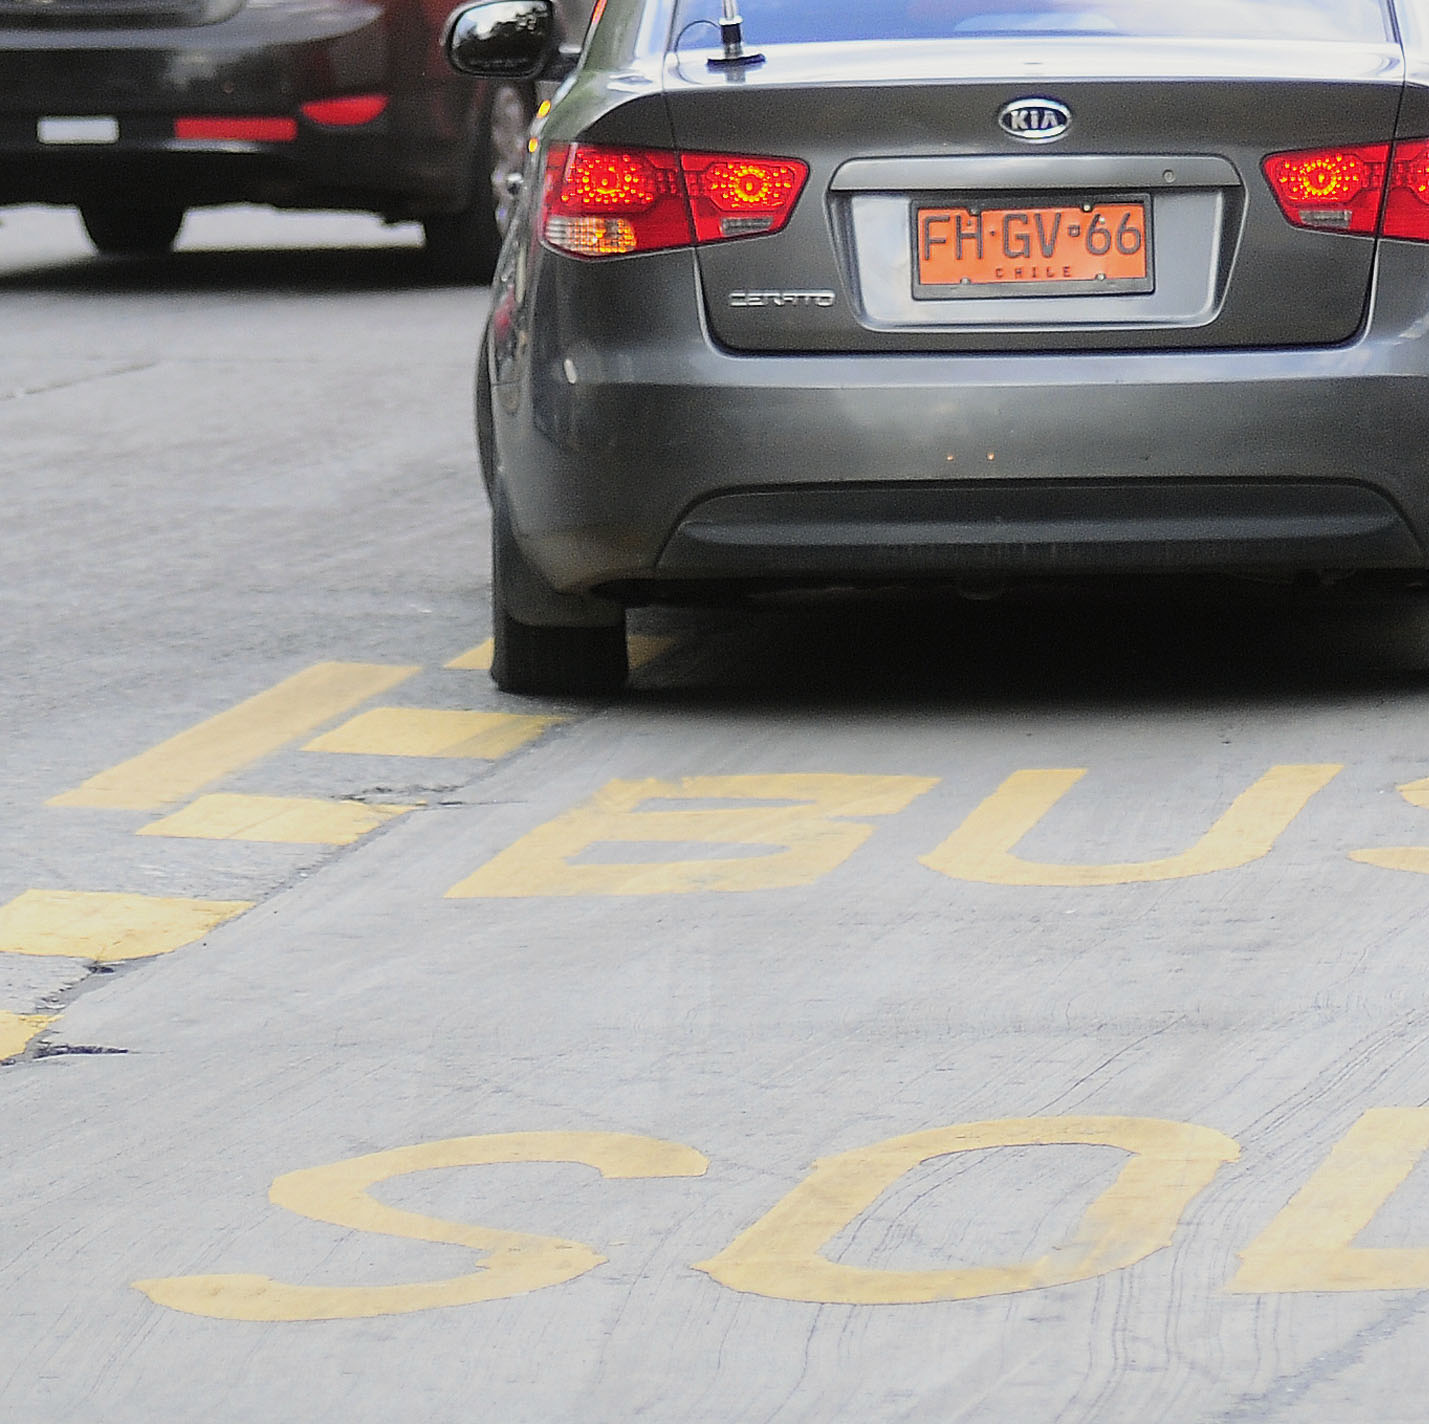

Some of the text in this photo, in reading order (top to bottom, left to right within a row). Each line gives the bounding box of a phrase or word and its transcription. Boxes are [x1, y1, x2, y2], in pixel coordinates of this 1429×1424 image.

[1010, 110, 1059, 130] KIA
[995, 266, 1073, 279] CHILE
[729, 289, 835, 308] CERATO
